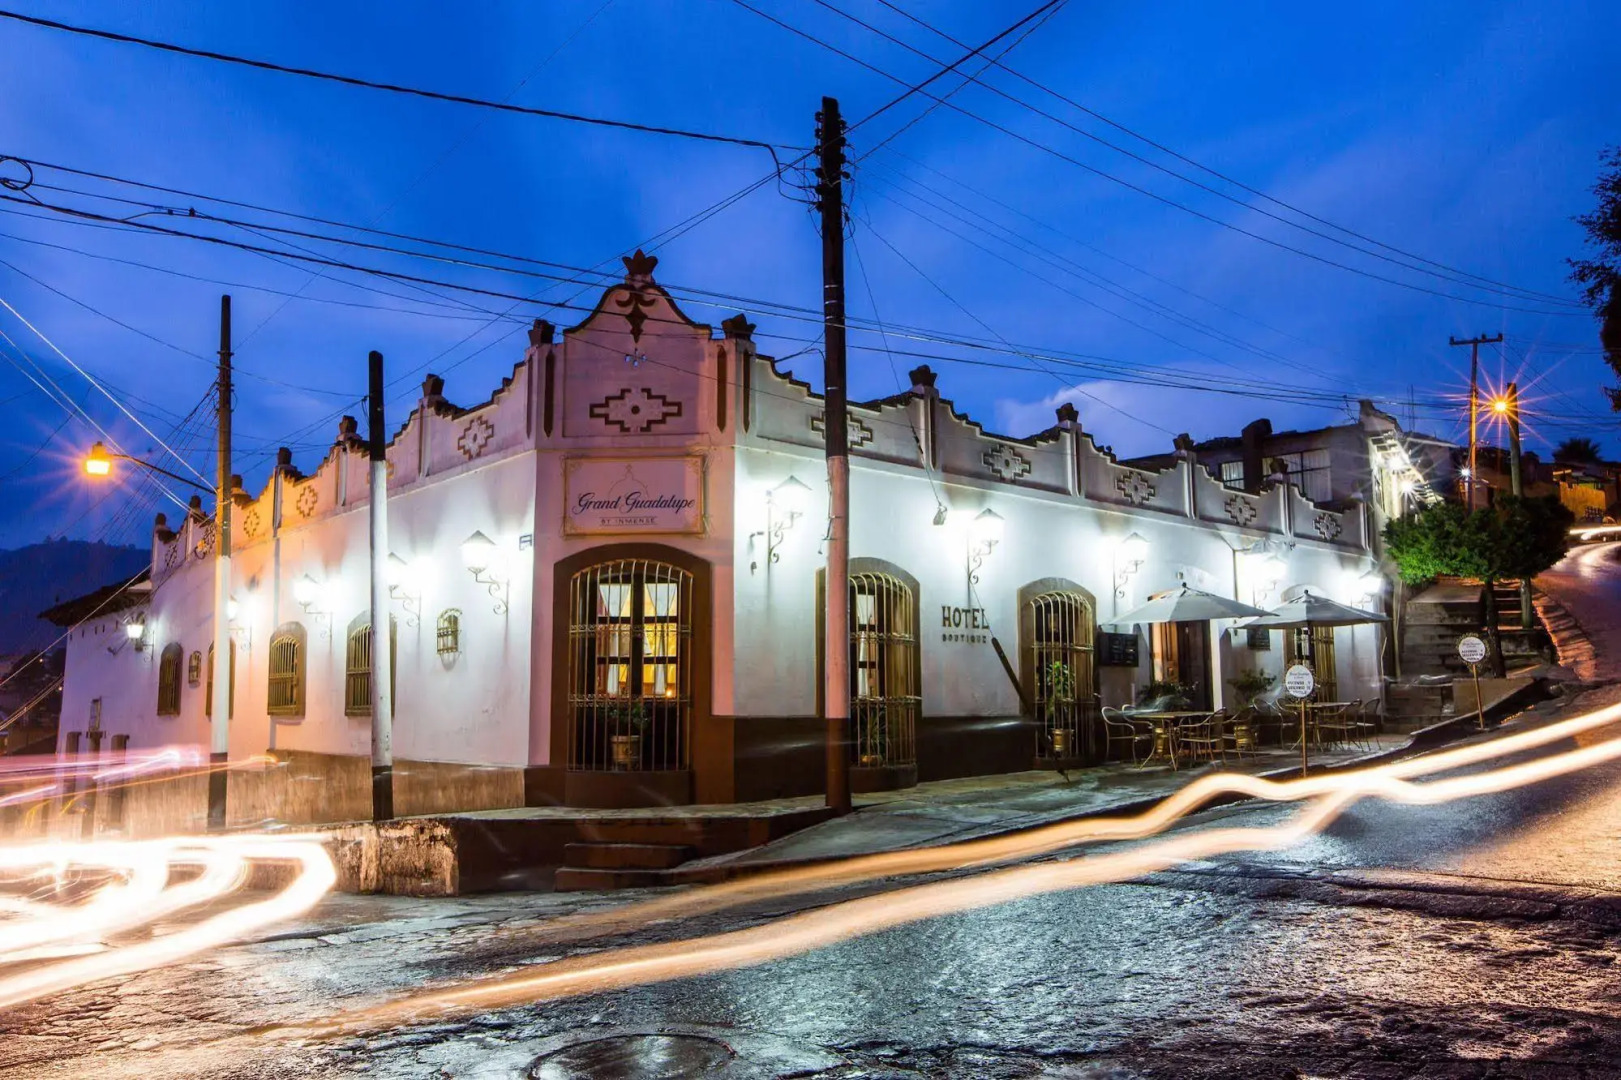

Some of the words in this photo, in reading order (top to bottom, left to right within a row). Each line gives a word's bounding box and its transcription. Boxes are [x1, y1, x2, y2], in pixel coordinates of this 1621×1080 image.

[572, 492, 621, 515] Grand
[620, 491, 695, 514] Guadalupe
[941, 606, 990, 629] HOTEL
[942, 634, 987, 643] BOUTIQUE
